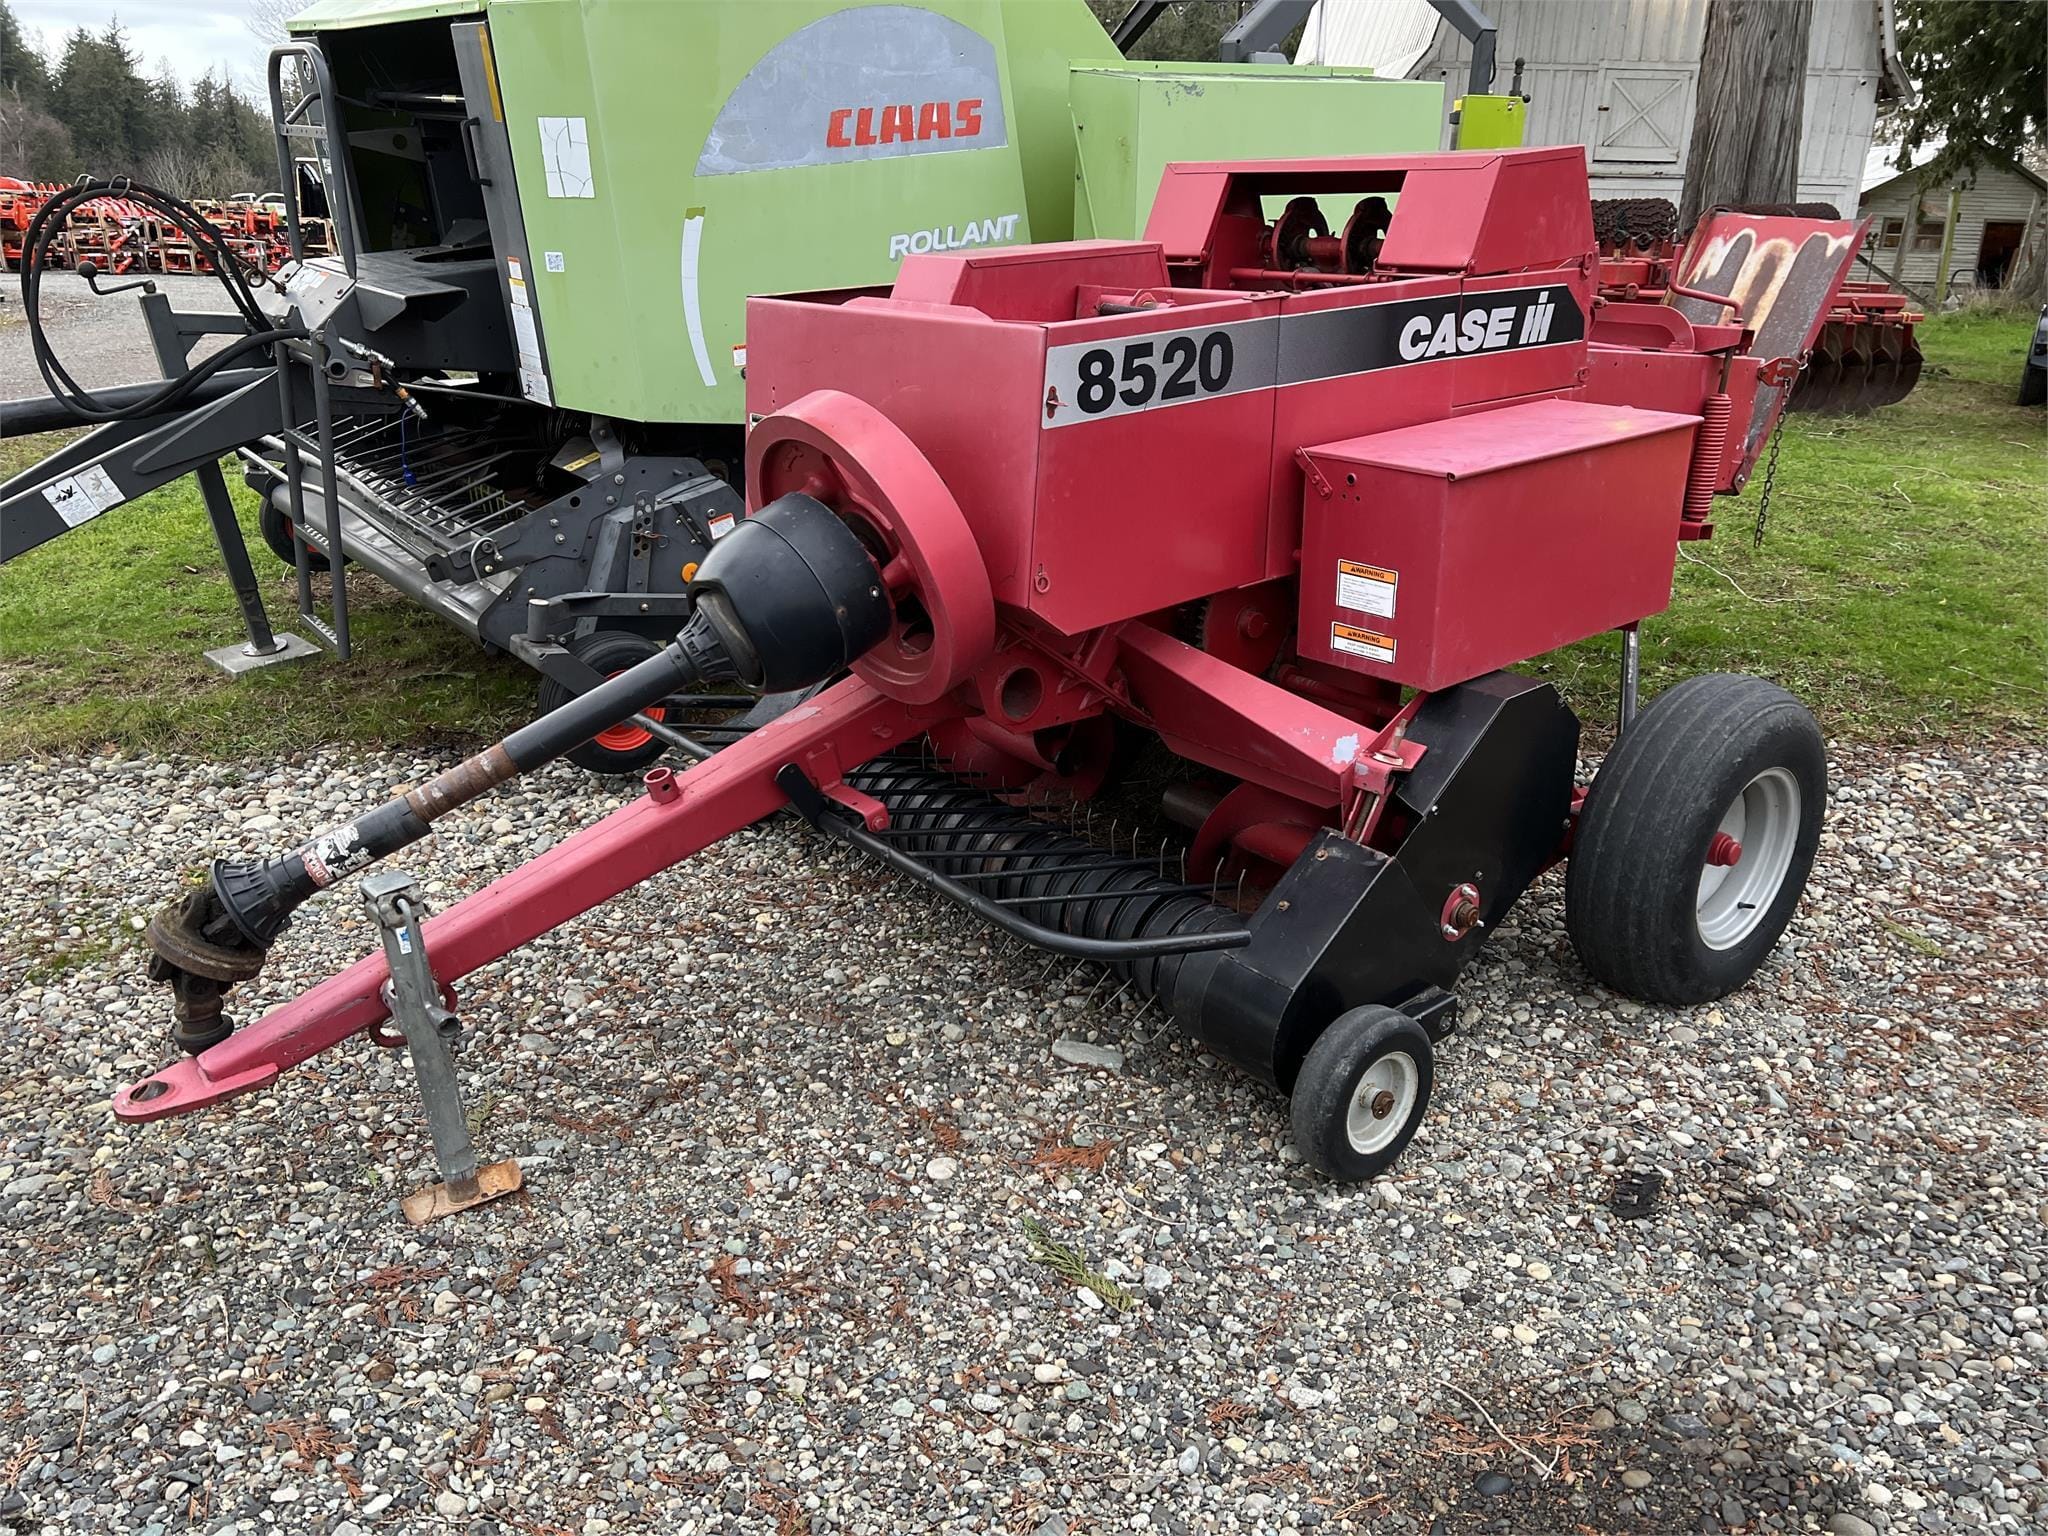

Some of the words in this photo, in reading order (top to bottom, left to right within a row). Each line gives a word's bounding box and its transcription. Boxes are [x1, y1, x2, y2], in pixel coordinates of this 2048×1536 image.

[826, 98, 984, 148] CLAAS
[889, 213, 1020, 260] ROLLANT
[1398, 308, 1517, 361] CASE
[1076, 331, 1234, 414] 8520
[1354, 567, 1385, 579] WARNING
[1350, 630, 1381, 644] WARNING
